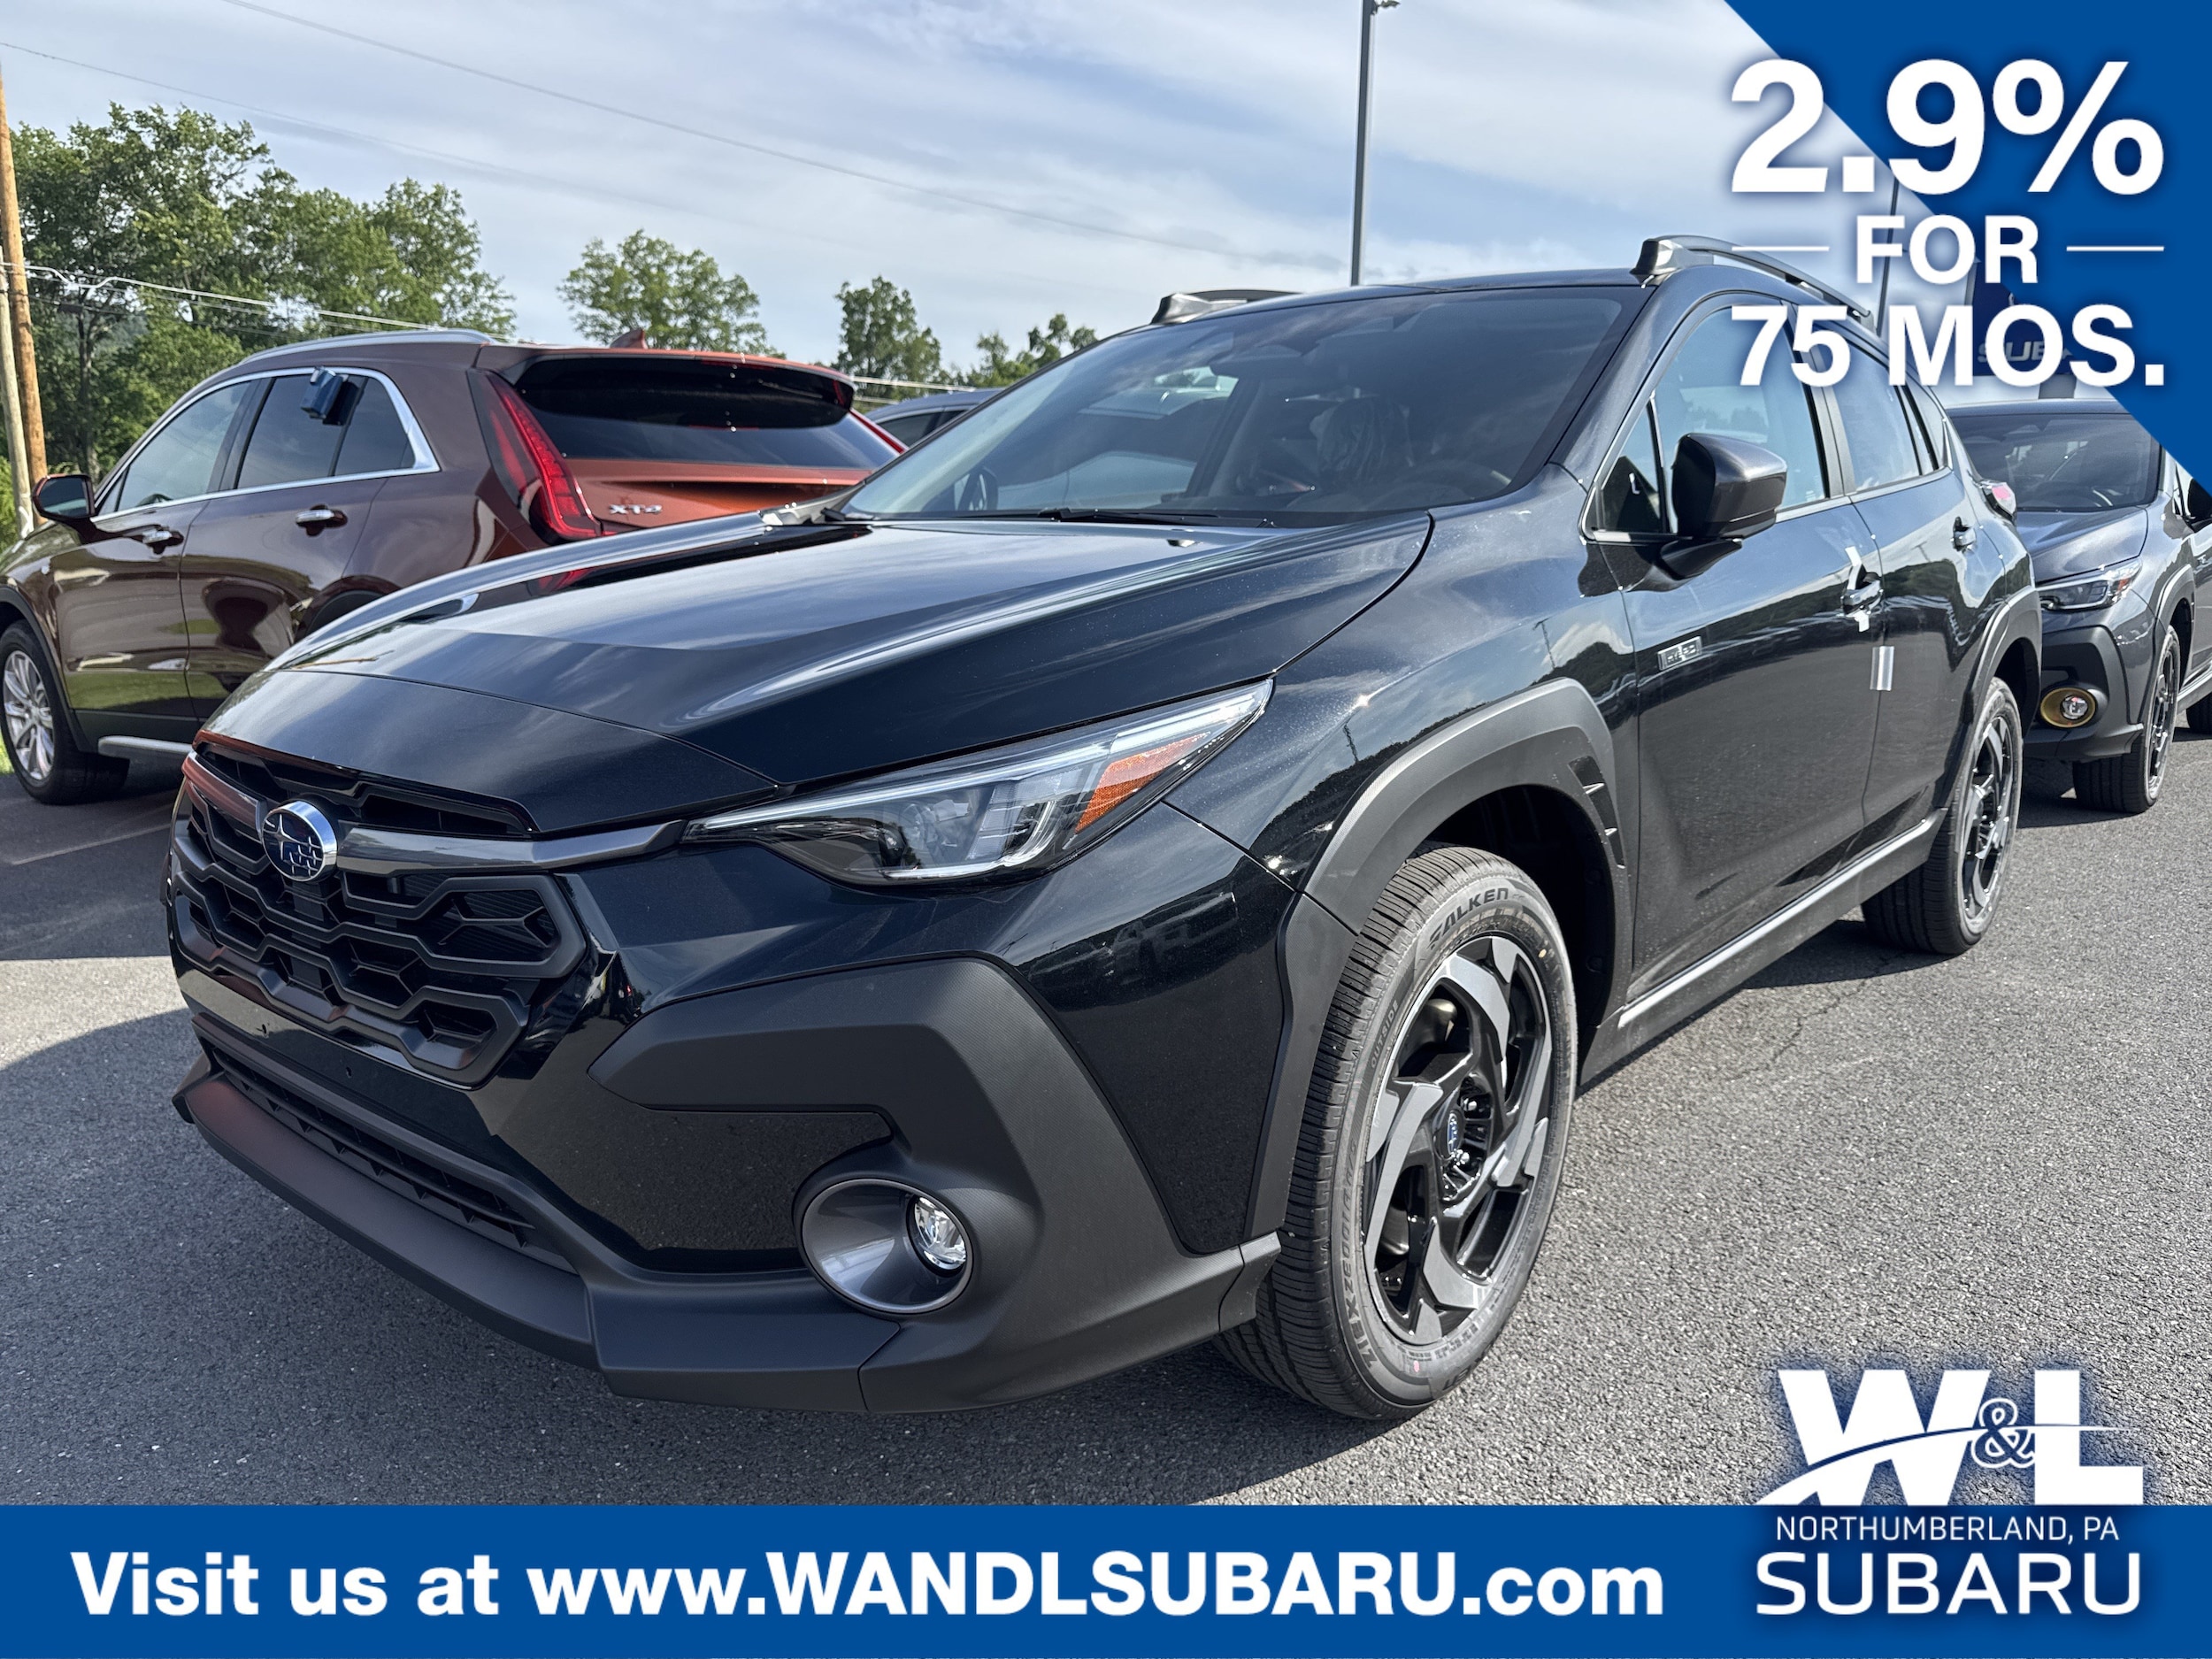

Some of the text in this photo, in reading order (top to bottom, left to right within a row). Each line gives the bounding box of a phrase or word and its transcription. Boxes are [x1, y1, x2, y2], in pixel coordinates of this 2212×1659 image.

[609, 503, 663, 514] XT4
[1427, 887, 1509, 950] FALKEN
[1371, 999, 1399, 1069] OUTSIDE
[1345, 1294, 1378, 1369] ZIEX
